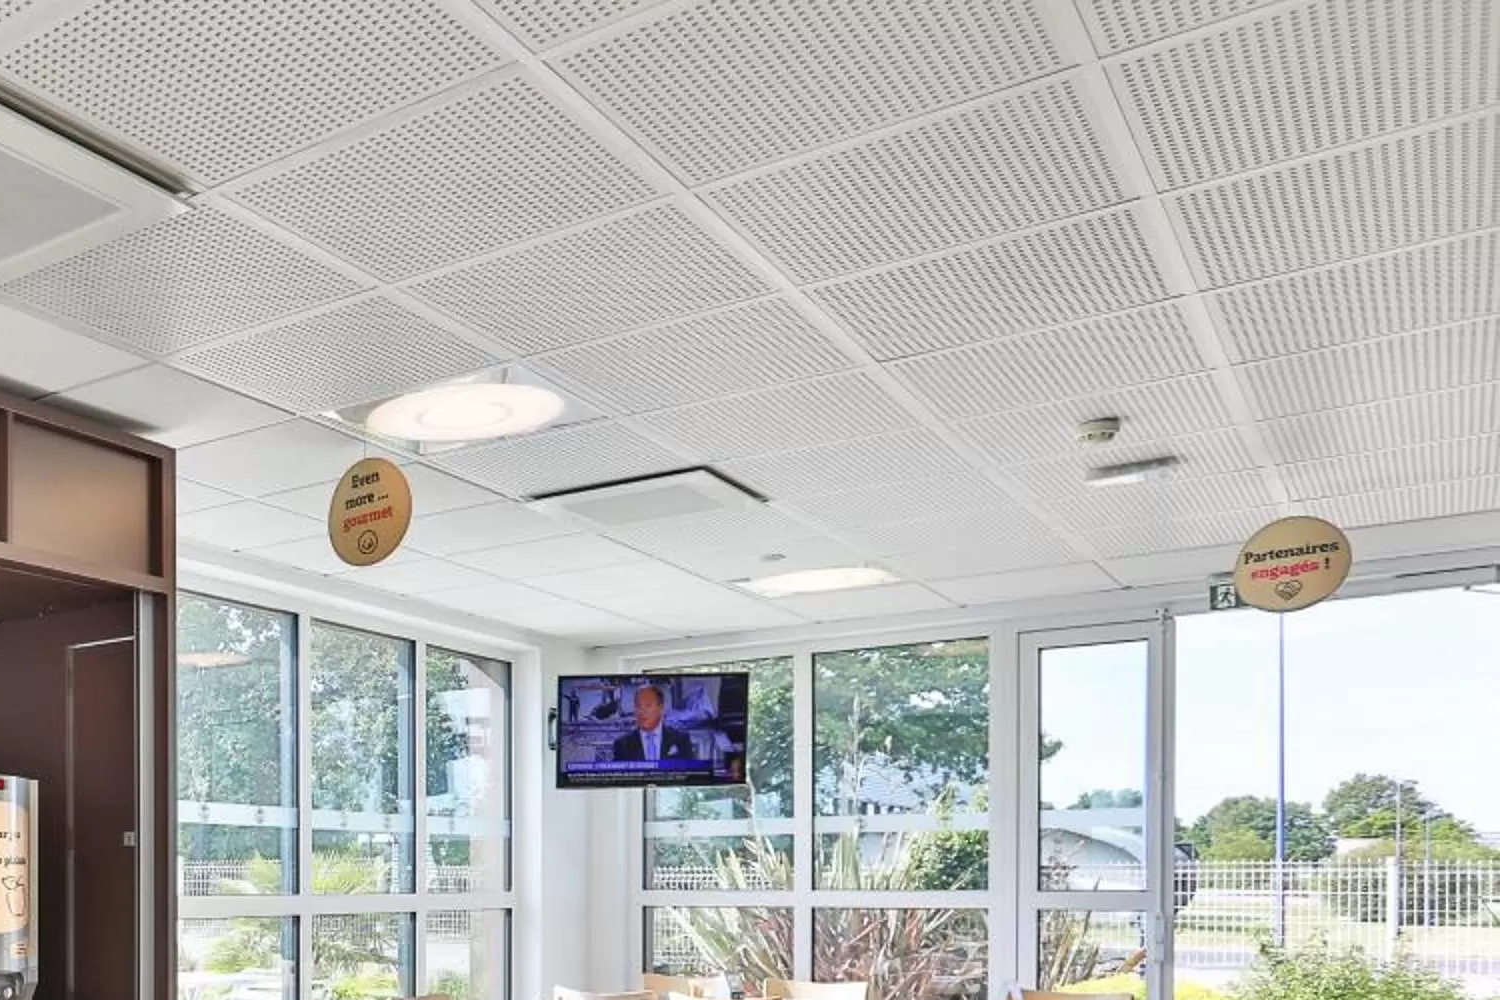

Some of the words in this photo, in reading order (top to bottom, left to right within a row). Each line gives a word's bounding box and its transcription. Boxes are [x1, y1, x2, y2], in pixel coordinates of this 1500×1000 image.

[351, 471, 380, 488] Even
[345, 491, 375, 510] more
[342, 505, 393, 533] gourmet
[1244, 541, 1340, 565] Partenaires
[1251, 558, 1320, 581] engagés
